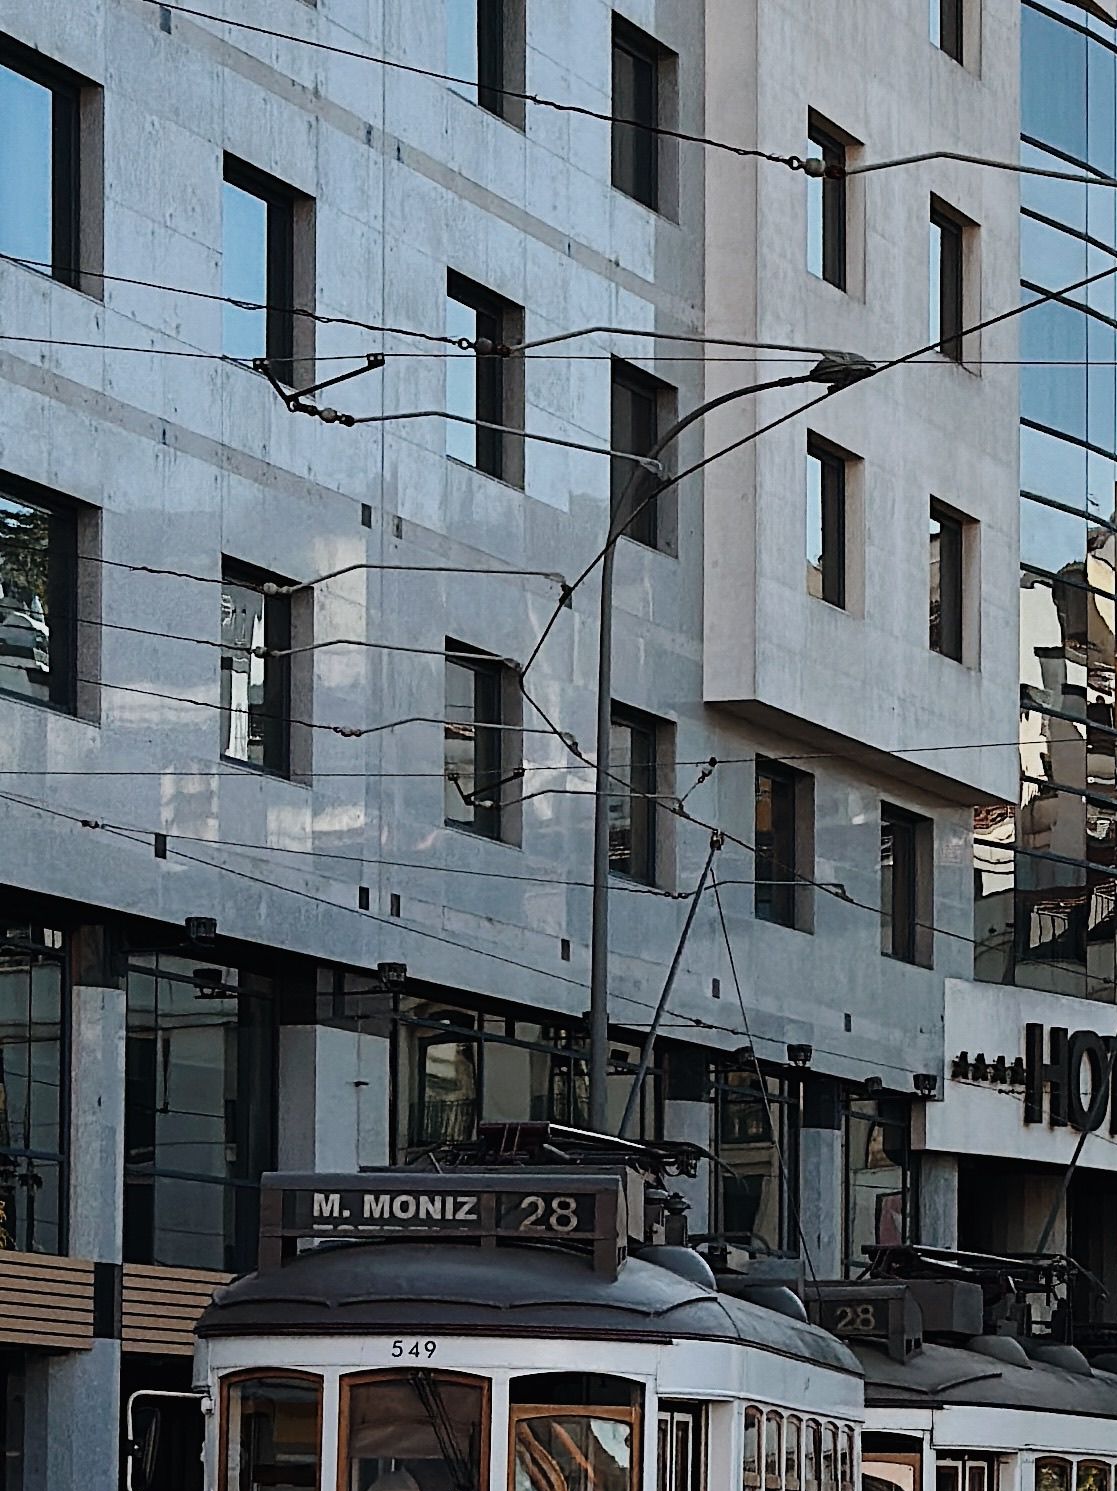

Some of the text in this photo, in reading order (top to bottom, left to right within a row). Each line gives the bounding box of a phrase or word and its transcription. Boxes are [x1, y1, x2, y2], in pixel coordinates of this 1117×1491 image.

[312, 1191, 478, 1221] M. MONIZ
[520, 1195, 578, 1233] 28
[836, 1304, 876, 1331] 28
[391, 1339, 437, 1359] 549
